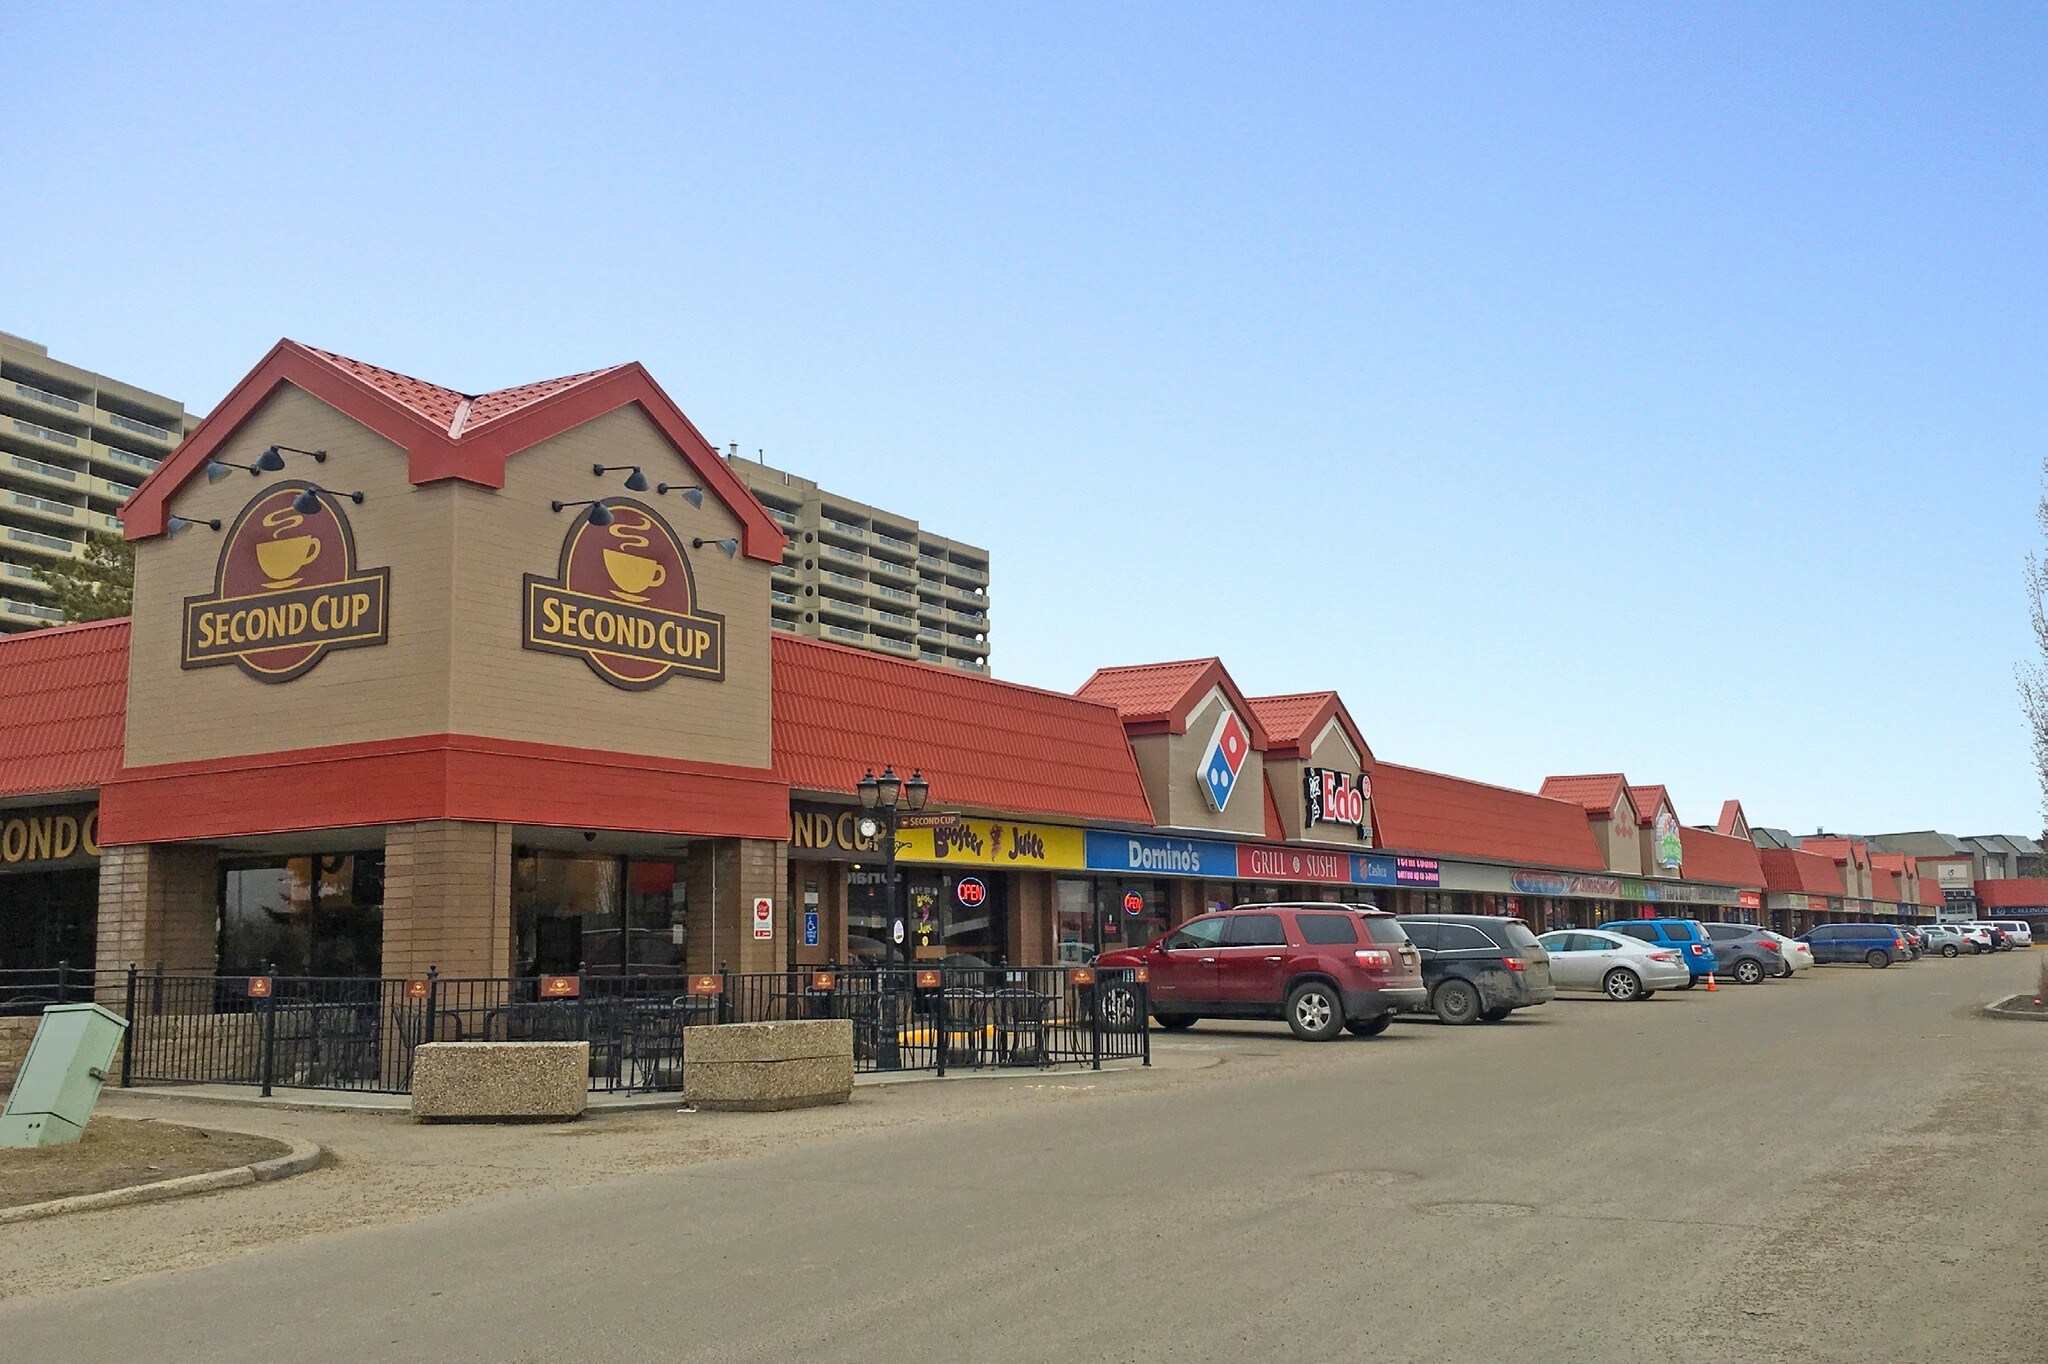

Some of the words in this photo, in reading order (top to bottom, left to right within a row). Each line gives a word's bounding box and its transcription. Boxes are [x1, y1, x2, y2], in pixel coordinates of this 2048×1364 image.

[198, 603, 308, 648] SECOND
[311, 594, 370, 632] CUP
[542, 597, 656, 649] SECOND
[659, 621, 711, 659] CUP
[1322, 769, 1363, 824] Edo
[789, 811, 833, 848] ND
[910, 816, 940, 826] SECOND
[940, 816, 956, 825] CUP
[0, 816, 78, 863] OND
[933, 824, 984, 858] Booster
[1008, 827, 1045, 860] Juice
[1129, 841, 1200, 873] Domino's
[1251, 851, 1287, 876] GRILL
[1307, 854, 1338, 878] SUSHI
[958, 884, 984, 901] OPEN
